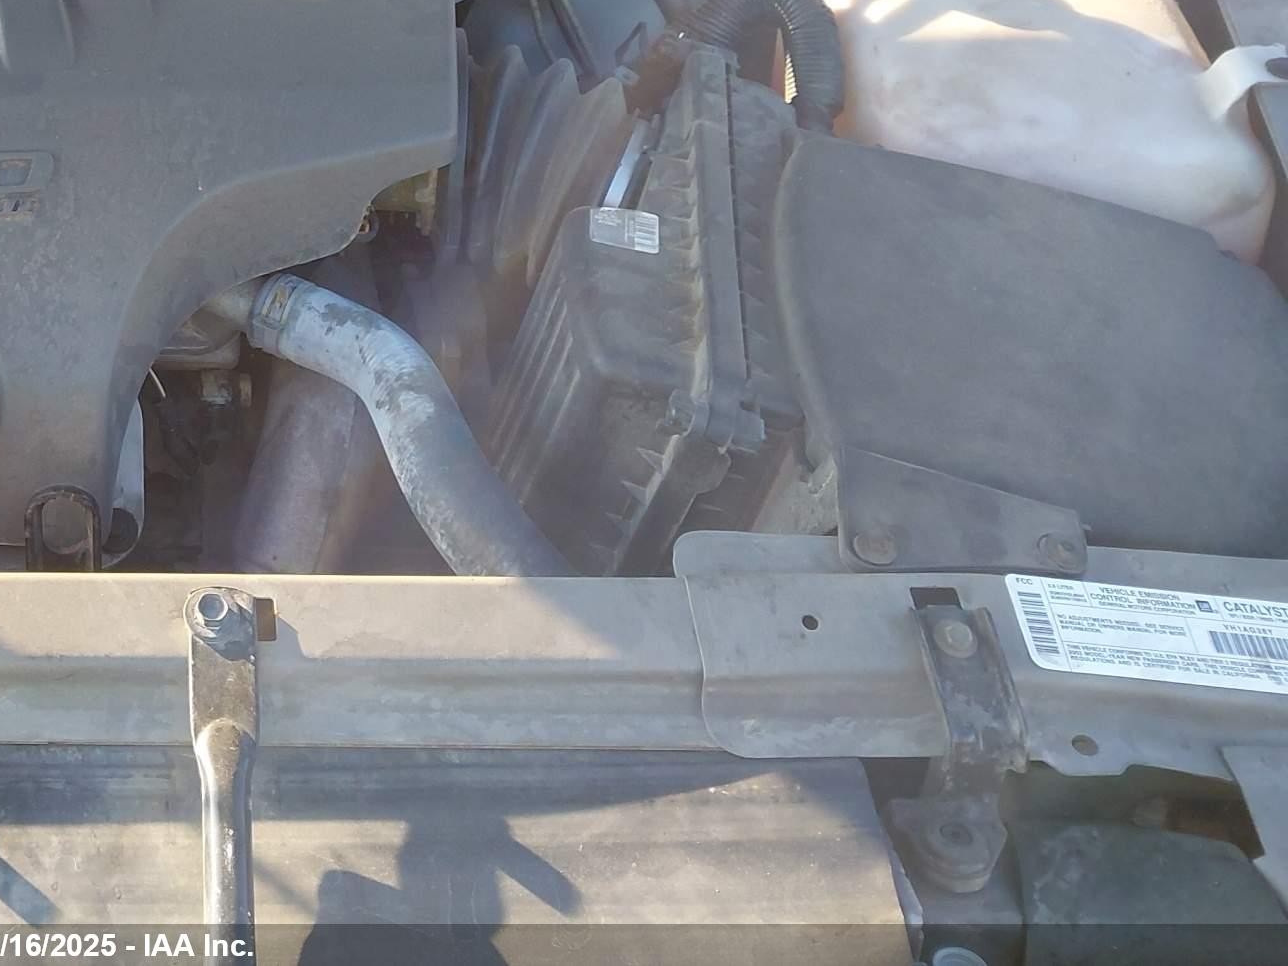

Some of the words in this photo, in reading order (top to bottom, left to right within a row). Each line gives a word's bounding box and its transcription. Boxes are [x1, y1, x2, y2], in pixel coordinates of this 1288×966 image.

[1015, 577, 1033, 585] FCC
[1099, 586, 1137, 596] VEHICLE
[1089, 593, 1133, 604] CONTROL
[1136, 598, 1196, 610] INFORMATION
[1223, 601, 1288, 618] CATALYST
